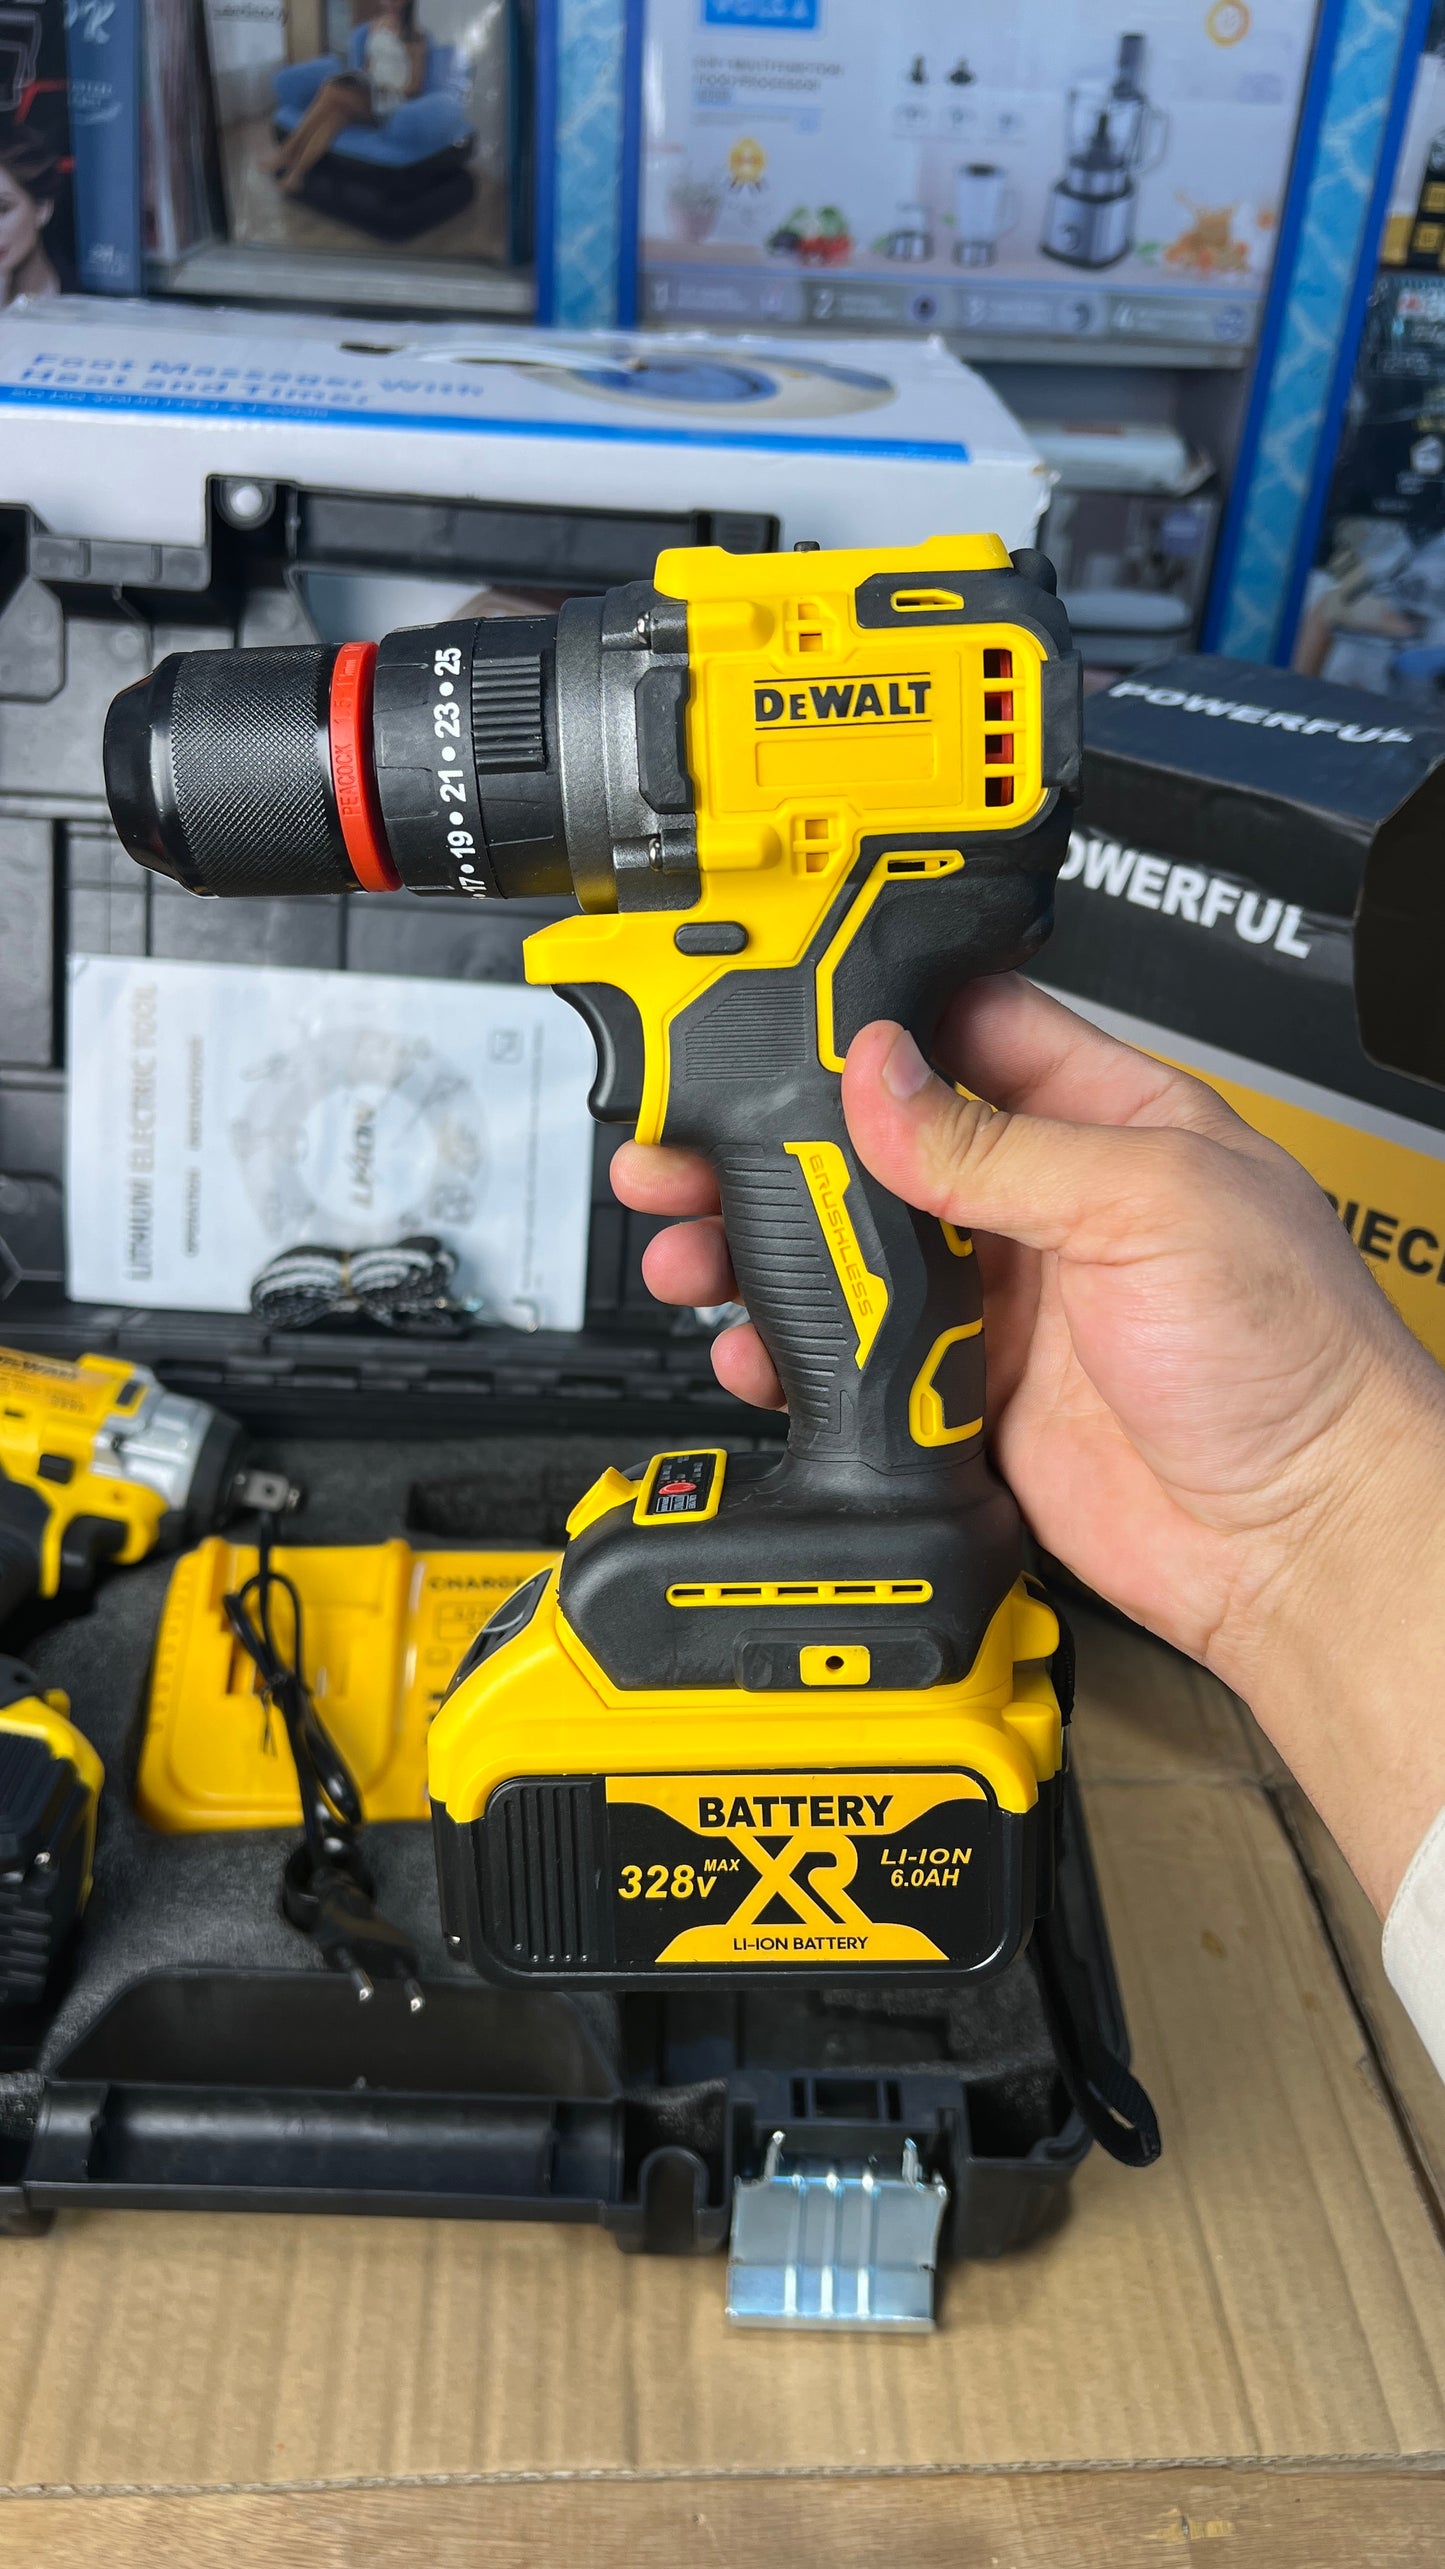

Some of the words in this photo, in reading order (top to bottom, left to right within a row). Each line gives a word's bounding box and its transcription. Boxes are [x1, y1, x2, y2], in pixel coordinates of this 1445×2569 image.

[434, 647, 462, 677] 25
[433, 701, 462, 739] 23
[334, 743, 361, 817] PEACOCK
[440, 769, 467, 803] 21
[447, 830, 476, 860] 19
[461, 876, 486, 894] 17
[809, 1154, 874, 1317] BRUSHLESS
[1322, 1188, 1445, 1289] IEC
[698, 1795, 893, 1829] BATTERY
[703, 1858, 741, 1872] MAX
[880, 1848, 972, 1866] LI-ION
[727, 1834, 873, 1926] XR
[890, 1868, 960, 1888] 6.0AH
[733, 1937, 788, 1951] LI-ION
[793, 1936, 869, 1951] BATTERY
